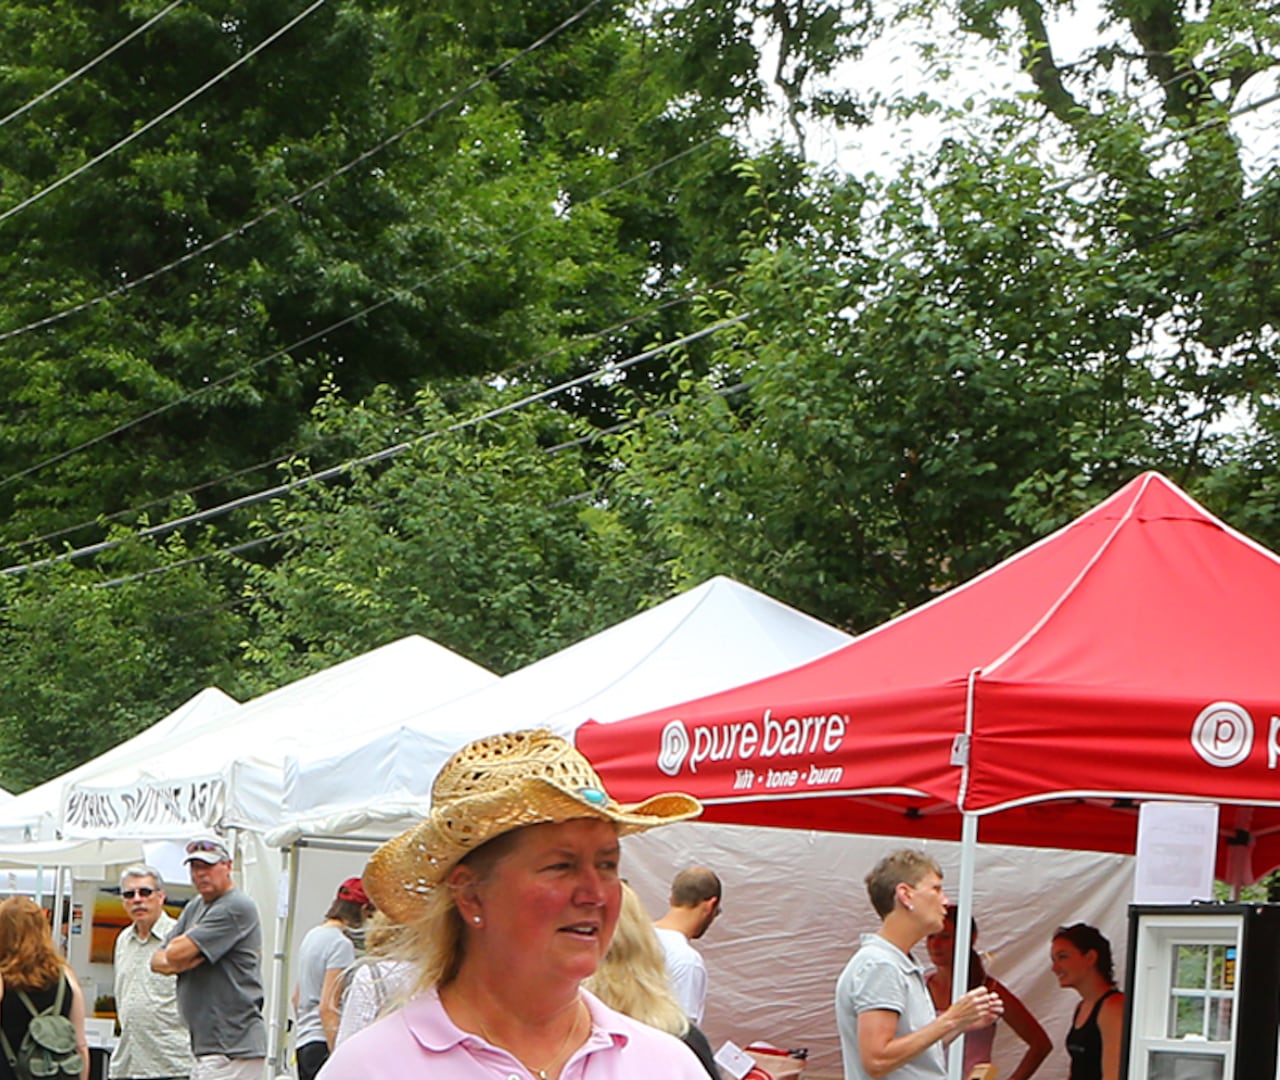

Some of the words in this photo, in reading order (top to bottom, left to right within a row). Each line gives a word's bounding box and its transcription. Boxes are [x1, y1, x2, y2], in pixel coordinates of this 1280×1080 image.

[689, 720, 759, 774] pure
[760, 708, 846, 758] barre
[733, 769, 755, 790] lift
[765, 768, 798, 789] tone
[806, 763, 845, 786] burn
